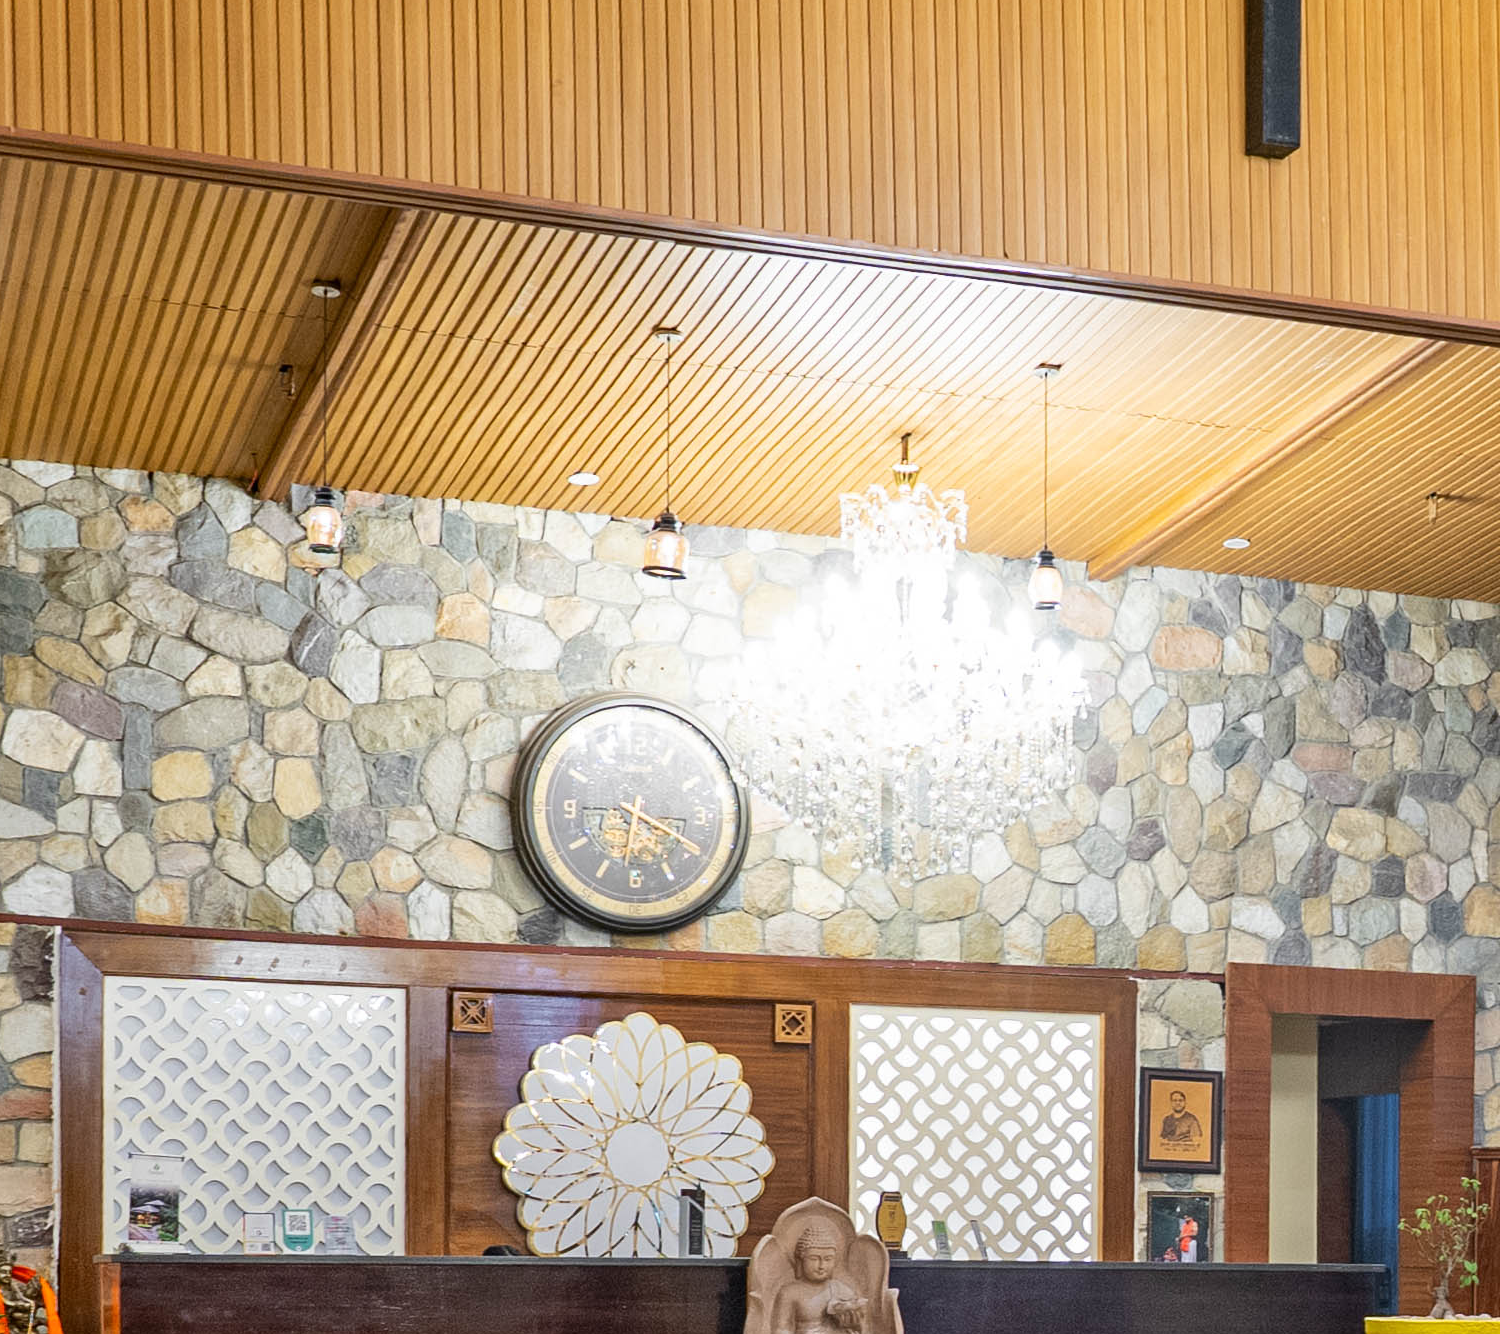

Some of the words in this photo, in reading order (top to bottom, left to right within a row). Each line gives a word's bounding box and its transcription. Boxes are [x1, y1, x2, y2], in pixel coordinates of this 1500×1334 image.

[564, 799, 577, 819] 9
[695, 806, 706, 825] 3
[629, 869, 642, 888] 6
